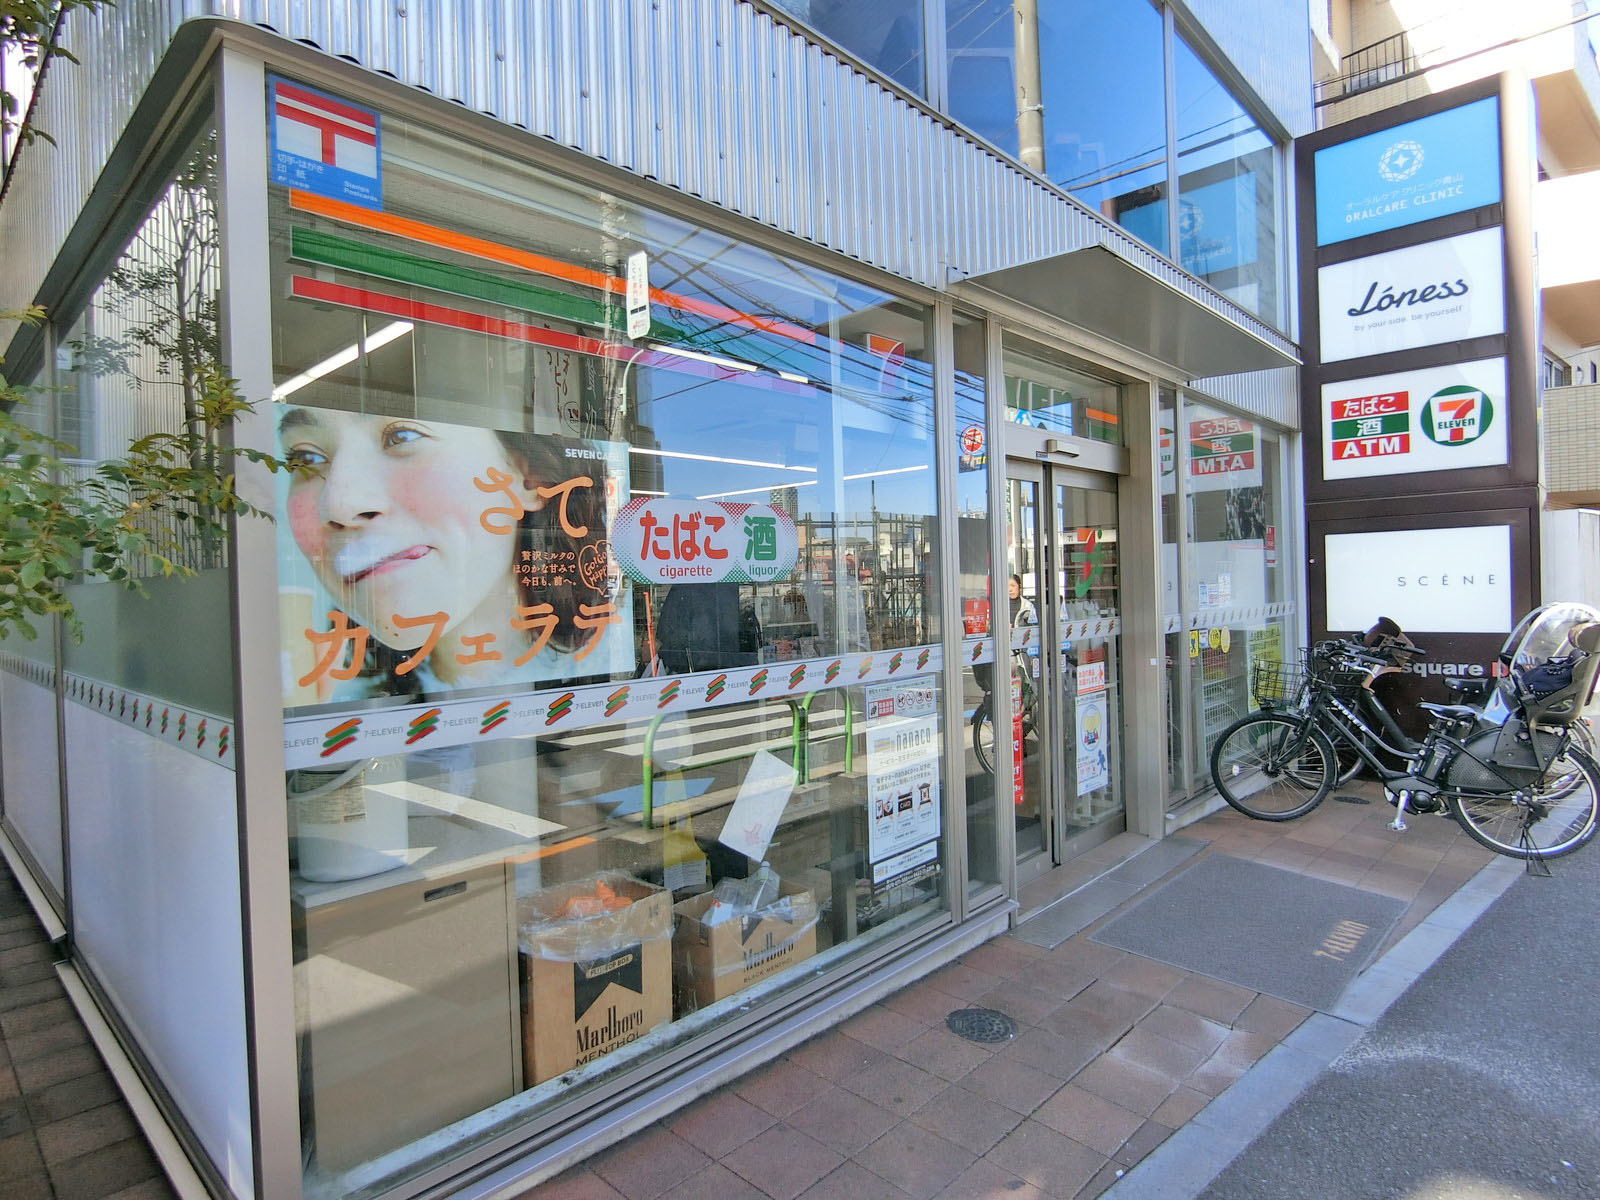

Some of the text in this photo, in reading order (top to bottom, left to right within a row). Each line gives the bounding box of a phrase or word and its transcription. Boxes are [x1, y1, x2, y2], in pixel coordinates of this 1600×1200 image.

[343, 180, 370, 193] Stamps
[343, 187, 378, 203] Postcards
[1345, 184, 1465, 223] ORALCARE CLINIC
[1367, 319, 1386, 330] your
[1410, 313, 1423, 321] be
[1424, 305, 1463, 319] yourself
[1343, 395, 1396, 418] たばこ
[1356, 417, 1382, 436] 酒
[564, 448, 596, 460] SEVEN
[1341, 436, 1401, 459] ATM
[473, 466, 594, 539] さて
[639, 509, 730, 563] たばこ
[743, 514, 778, 562] 酒
[521, 550, 576, 562] 贅沢ミルクの
[512, 564, 576, 574] ほのかな甘みで
[659, 565, 713, 580] cigarette
[748, 564, 779, 578] liquor
[521, 576, 577, 587] 今日も、前へ。
[297, 601, 623, 688] カフェラテ
[1400, 662, 1484, 678] square
[896, 727, 931, 751] nanaco
[617, 955, 630, 967] BOX
[743, 932, 794, 973] Marlboro
[576, 1005, 643, 1055] Marlboro
[575, 1031, 644, 1067] MENTHOL
